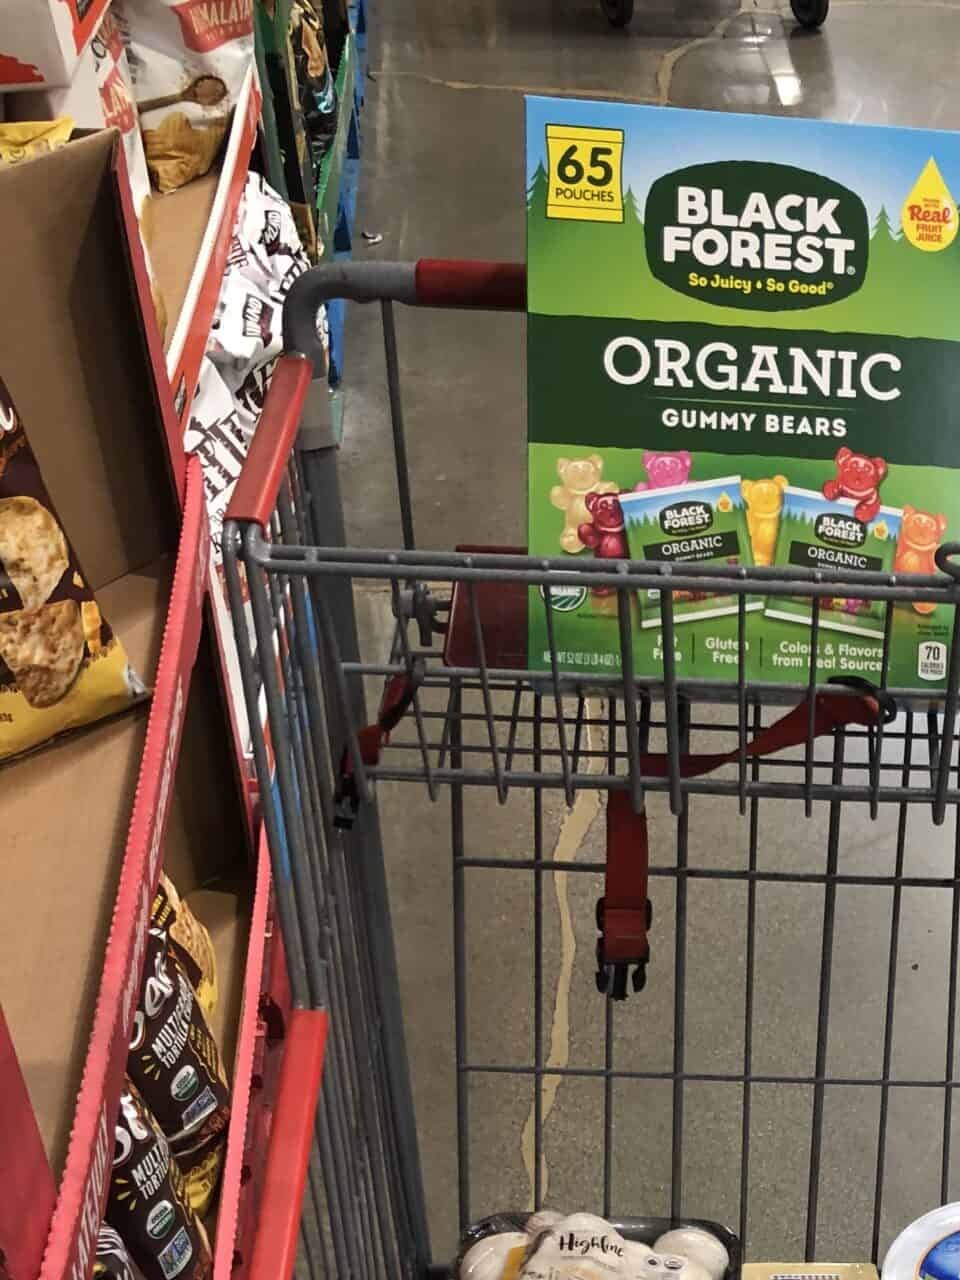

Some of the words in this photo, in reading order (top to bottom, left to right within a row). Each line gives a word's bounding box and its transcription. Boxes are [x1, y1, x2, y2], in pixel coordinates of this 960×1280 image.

[556, 144, 614, 187] 65
[555, 186, 615, 203] POUCHES
[677, 186, 840, 235] BLACK
[908, 204, 952, 224] Real
[916, 223, 943, 233] FRUIT
[916, 233, 943, 243] JUICE
[662, 227, 855, 275] FOREST
[688, 273, 708, 288] So
[710, 275, 752, 295] Juicy
[766, 279, 785, 292] So
[788, 280, 827, 296] Good
[603, 336, 902, 401] ORGANIC
[661, 408, 756, 432] GUMMY
[765, 416, 848, 438] BEARS
[663, 513, 711, 530] FOREST
[665, 504, 705, 520] BLACK
[817, 524, 863, 542] FOREST
[822, 516, 861, 532] BLACK
[661, 535, 723, 556] ORGANIC
[807, 547, 868, 568] ORGANIC
[773, 654, 802, 667] from
[926, 646, 940, 661] 70
